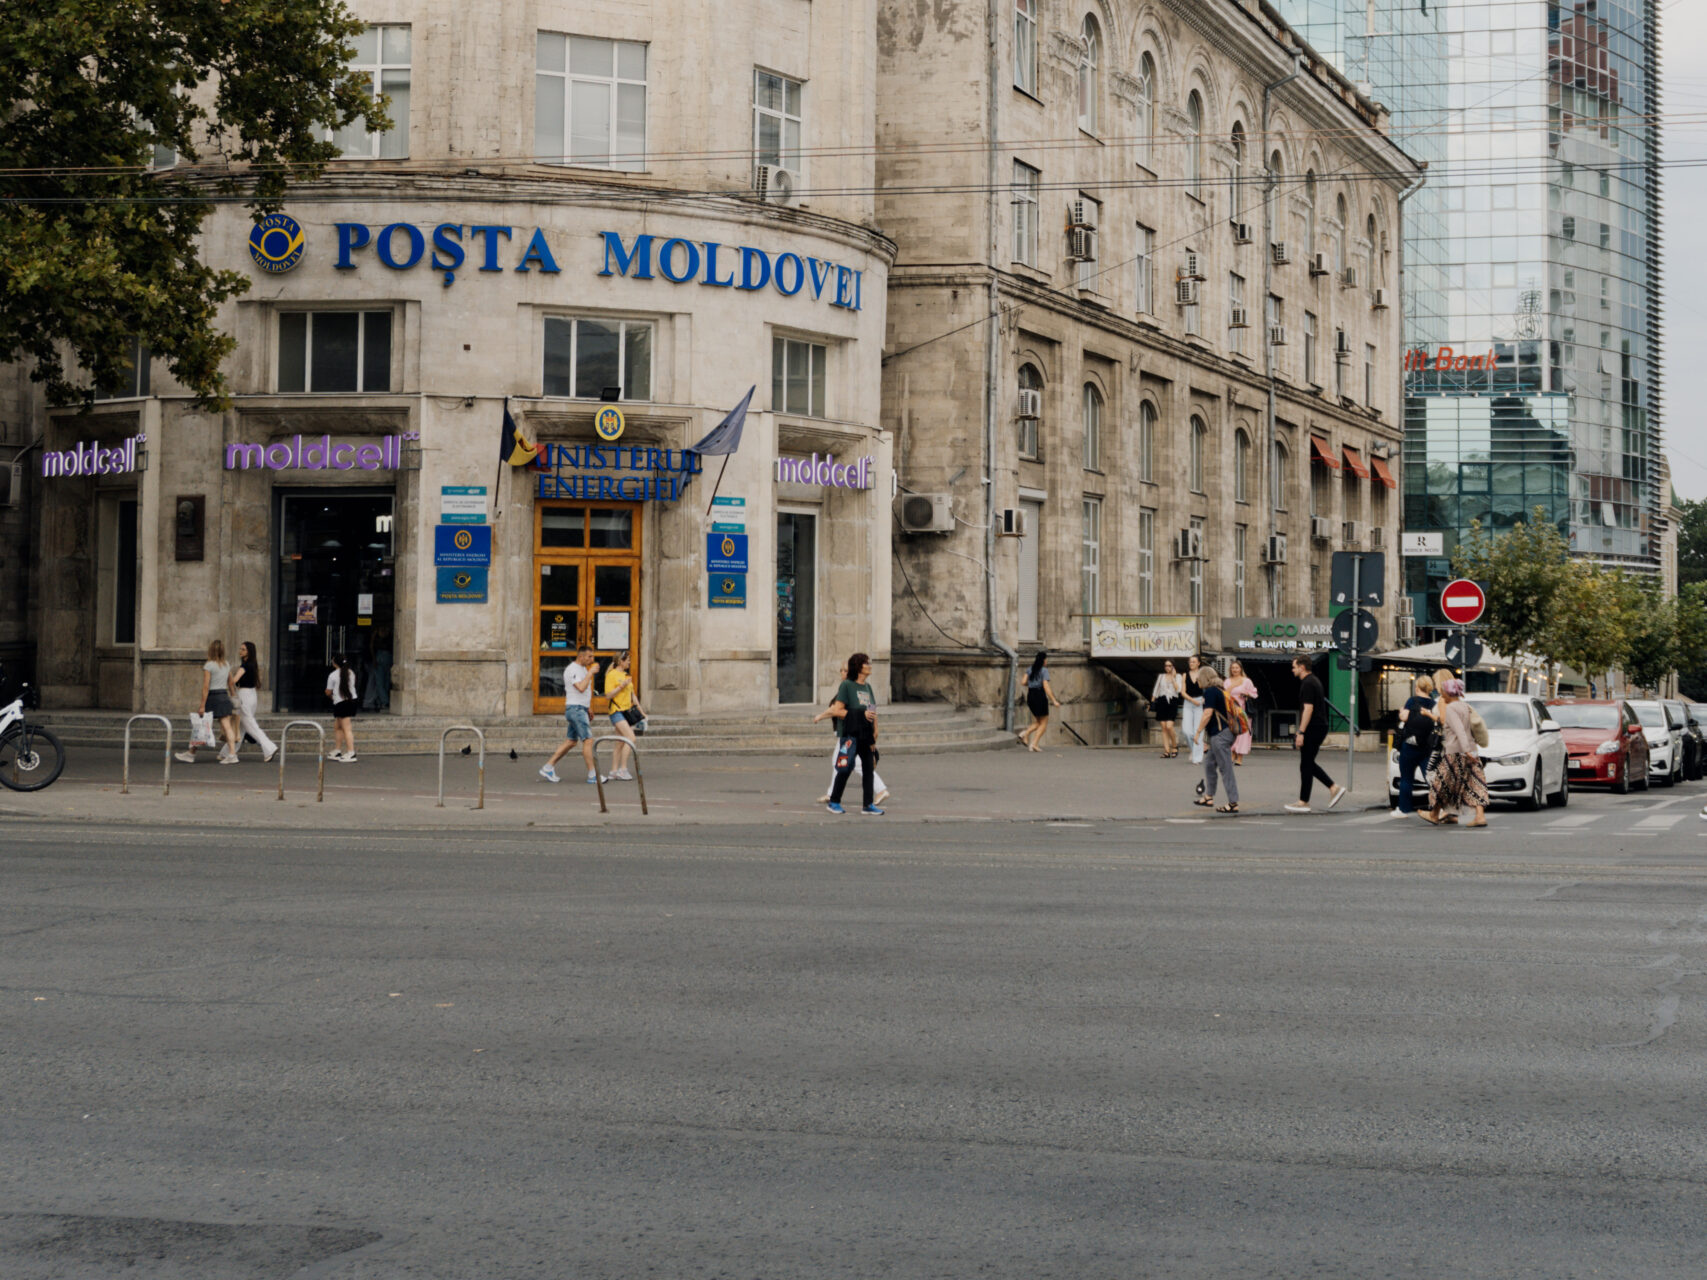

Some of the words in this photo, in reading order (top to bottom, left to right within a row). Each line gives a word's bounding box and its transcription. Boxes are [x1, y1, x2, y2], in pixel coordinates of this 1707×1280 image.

[255, 251, 300, 271] MOLDOVEI
[333, 222, 562, 287] POȘTA
[598, 230, 863, 312] MOLDOVEI
[1435, 347, 1500, 371] Bank
[42, 437, 136, 477] moldcell
[226, 434, 402, 470] moldcell
[534, 443, 703, 473] INISTERUL
[777, 452, 868, 490] moldcell
[538, 473, 679, 502] ENERGIEI
[1123, 622, 1149, 631] bistro
[1253, 623, 1298, 637] ALCO
[1300, 624, 1333, 635] MARK
